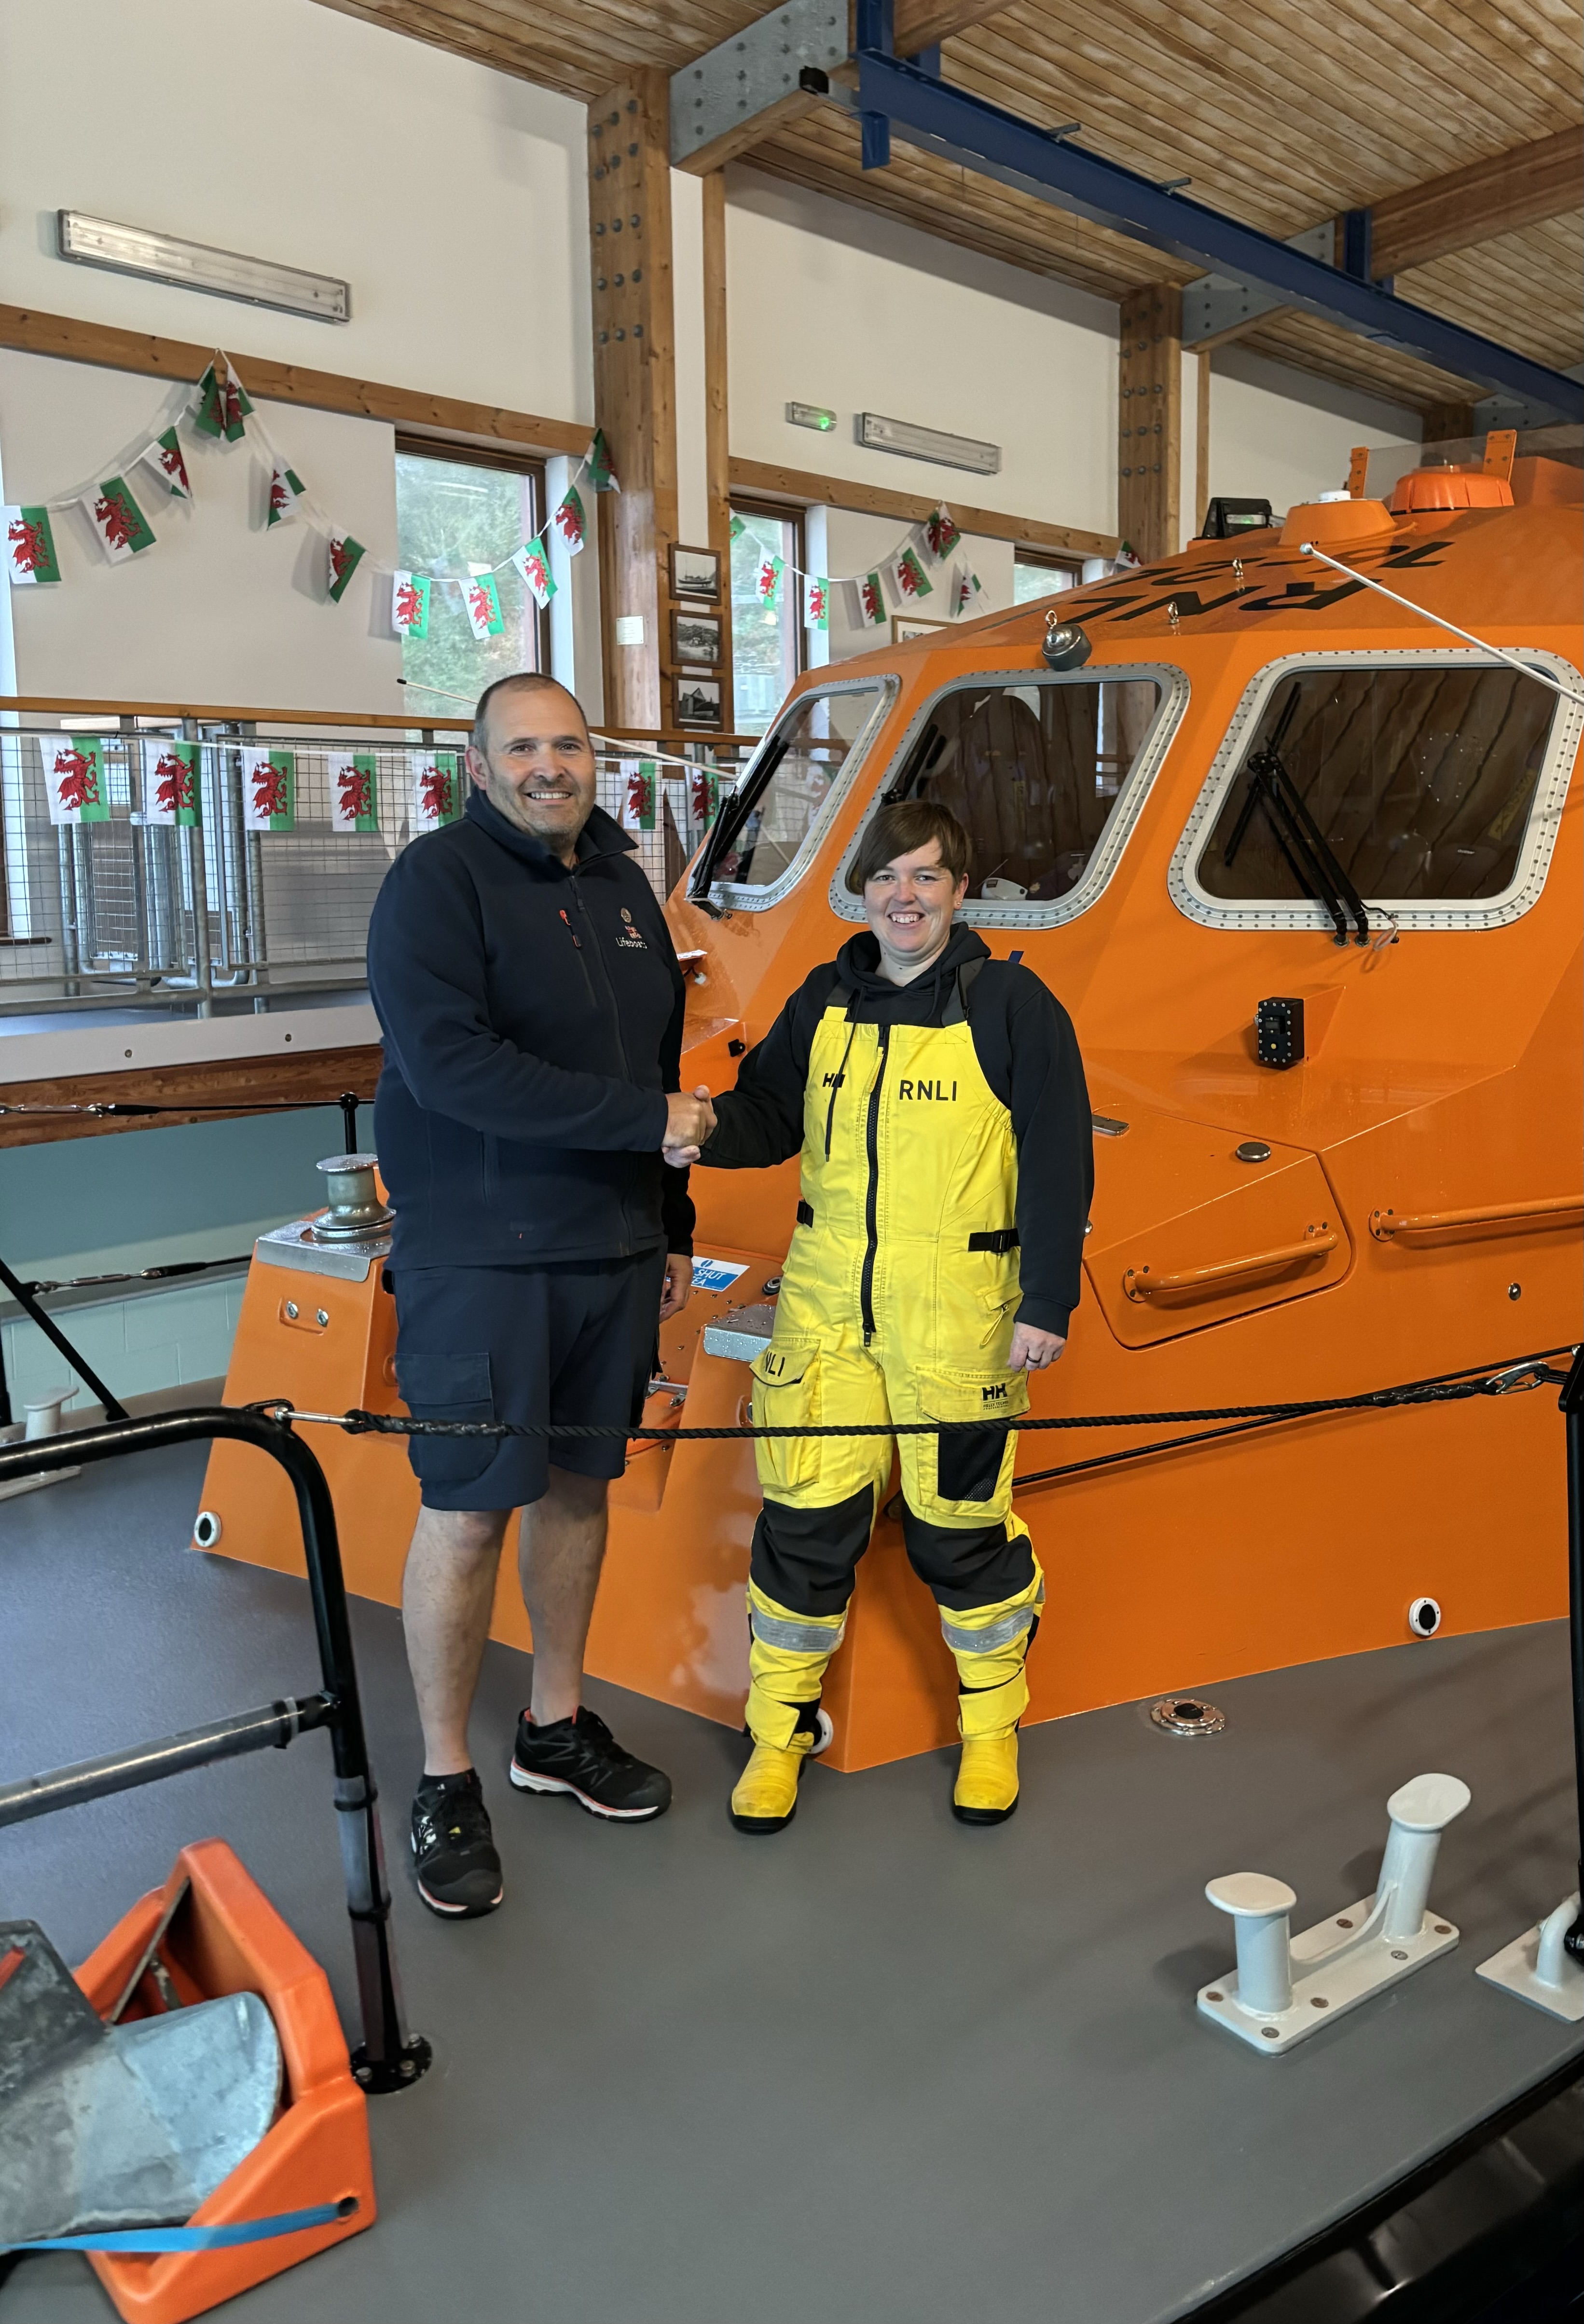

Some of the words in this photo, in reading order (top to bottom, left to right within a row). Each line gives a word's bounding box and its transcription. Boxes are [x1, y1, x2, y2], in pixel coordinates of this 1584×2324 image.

[899, 1080, 958, 1102] RNLI
[691, 1276, 706, 1286] EA
[694, 1269, 727, 1280] SHUT
[981, 1382, 1008, 1400] HH
